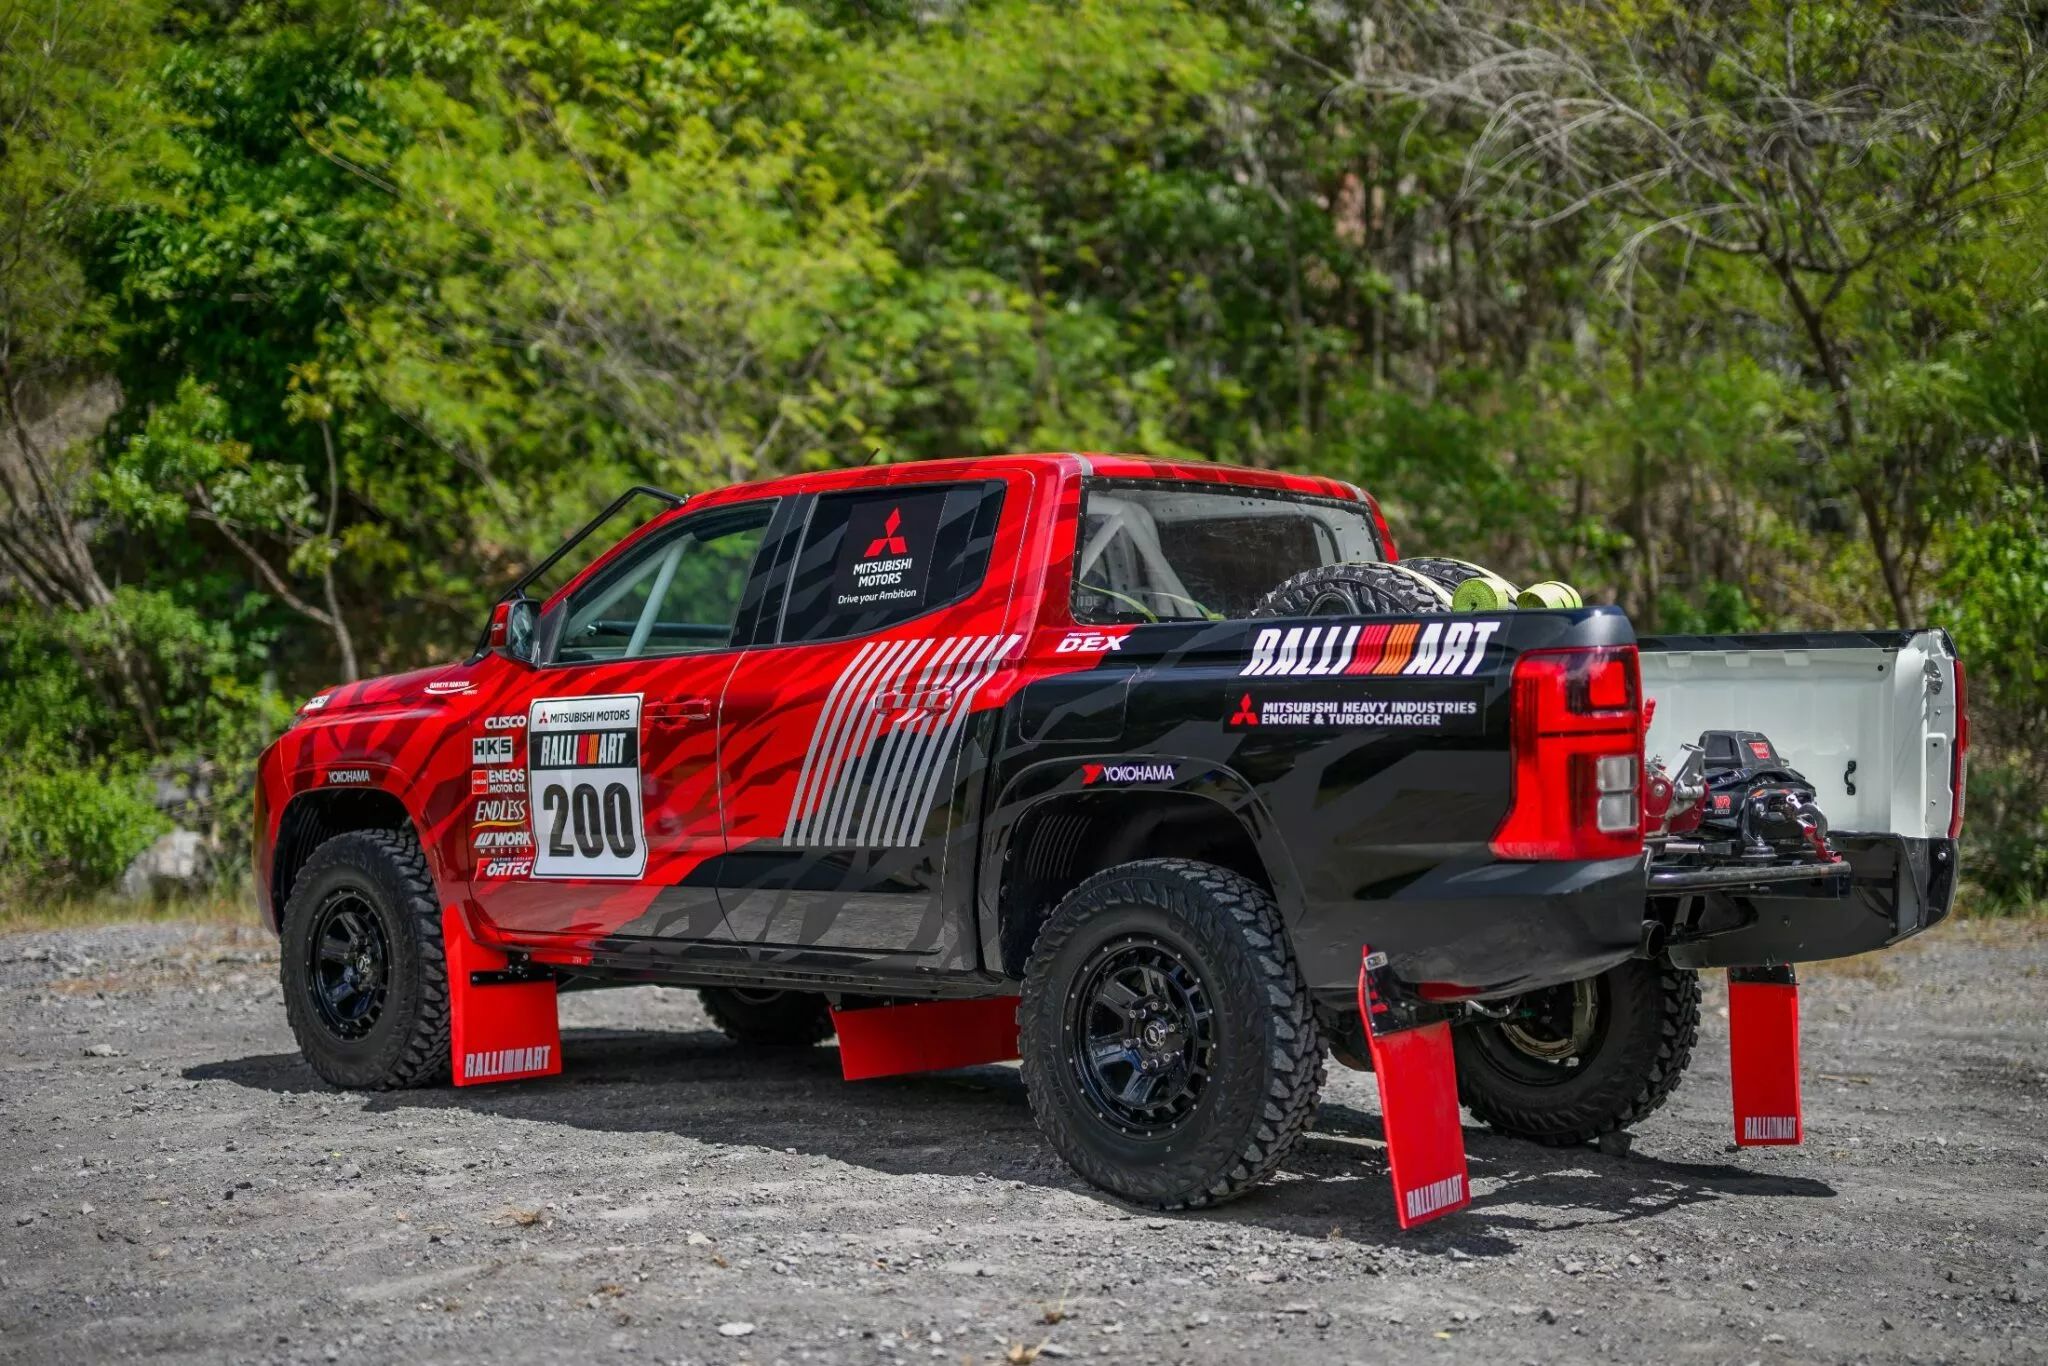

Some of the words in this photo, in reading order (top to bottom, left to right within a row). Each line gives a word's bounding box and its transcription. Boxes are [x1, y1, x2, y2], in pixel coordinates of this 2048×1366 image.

[853, 558, 913, 575] MITSUBISHI
[858, 572, 902, 588] MOTORS
[837, 594, 859, 604] Drive
[859, 593, 878, 605] your
[879, 588, 917, 600] Ambition
[1055, 634, 1131, 653] DEX
[1239, 621, 1501, 676] RALLIART
[1262, 702, 1338, 713] MITSUBISHI
[1342, 702, 1389, 713] HEAVY
[1391, 702, 1477, 714] INDUSTRIES
[484, 715, 527, 729] CUSCO
[550, 712, 595, 724] MITSUBISHI
[596, 709, 631, 722] MOTORS
[1261, 713, 1310, 725] ENGINE
[1313, 714, 1325, 725] &
[1328, 713, 1441, 726] TURBOCHARGER
[474, 738, 512, 756] HKS
[540, 732, 627, 767] RALLIART
[328, 769, 370, 783] YOKOHAMA
[488, 768, 526, 784] ENEOS
[1103, 764, 1175, 782] YOKOHAMA
[489, 784, 514, 793] MOTOR
[514, 783, 526, 793] OIL
[475, 799, 526, 822] ENDLESS
[543, 782, 636, 859] 200
[494, 832, 531, 846] WORK
